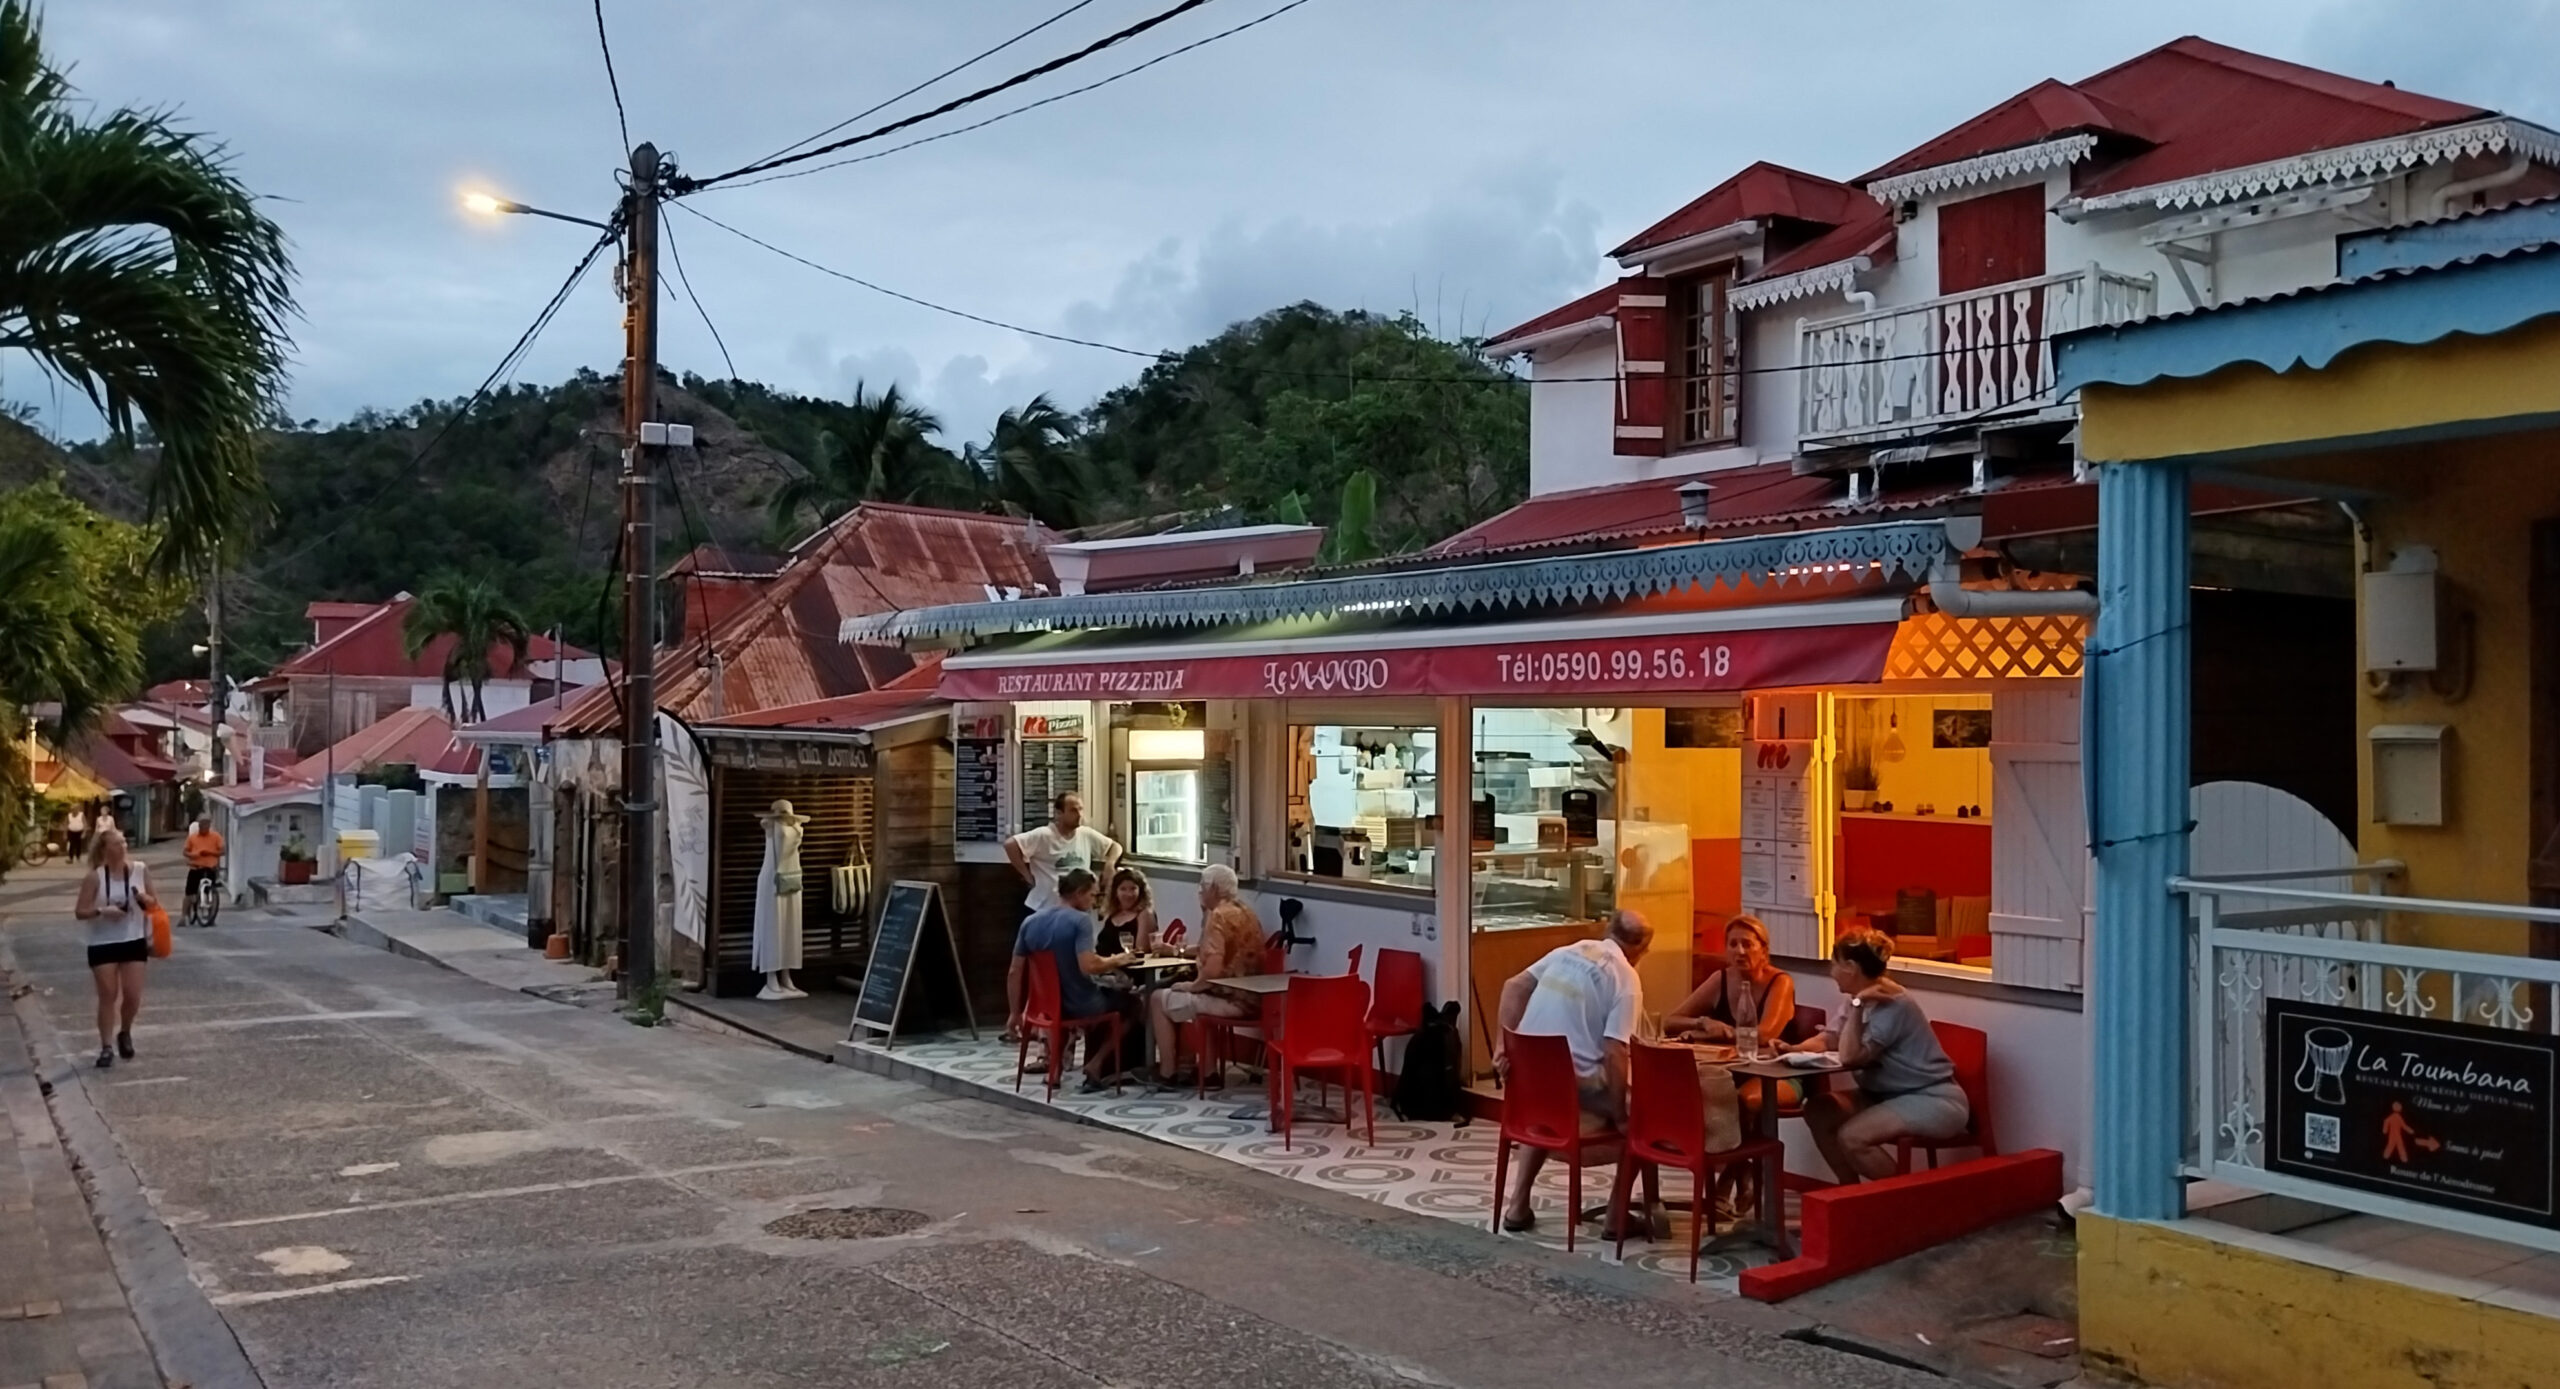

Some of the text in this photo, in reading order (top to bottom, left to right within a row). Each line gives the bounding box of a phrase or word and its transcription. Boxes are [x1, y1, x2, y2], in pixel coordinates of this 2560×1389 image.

[998, 669, 1184, 694] RESTAURANT PIZZERIA
[1263, 658, 1389, 695] Le MAMBO
[1497, 645, 1730, 682] Tél:0590.99.56.18
[2356, 1044, 2532, 1094] La Toumbana
[2389, 1165, 2418, 1179] Route
[2419, 1171, 2432, 1181] de
